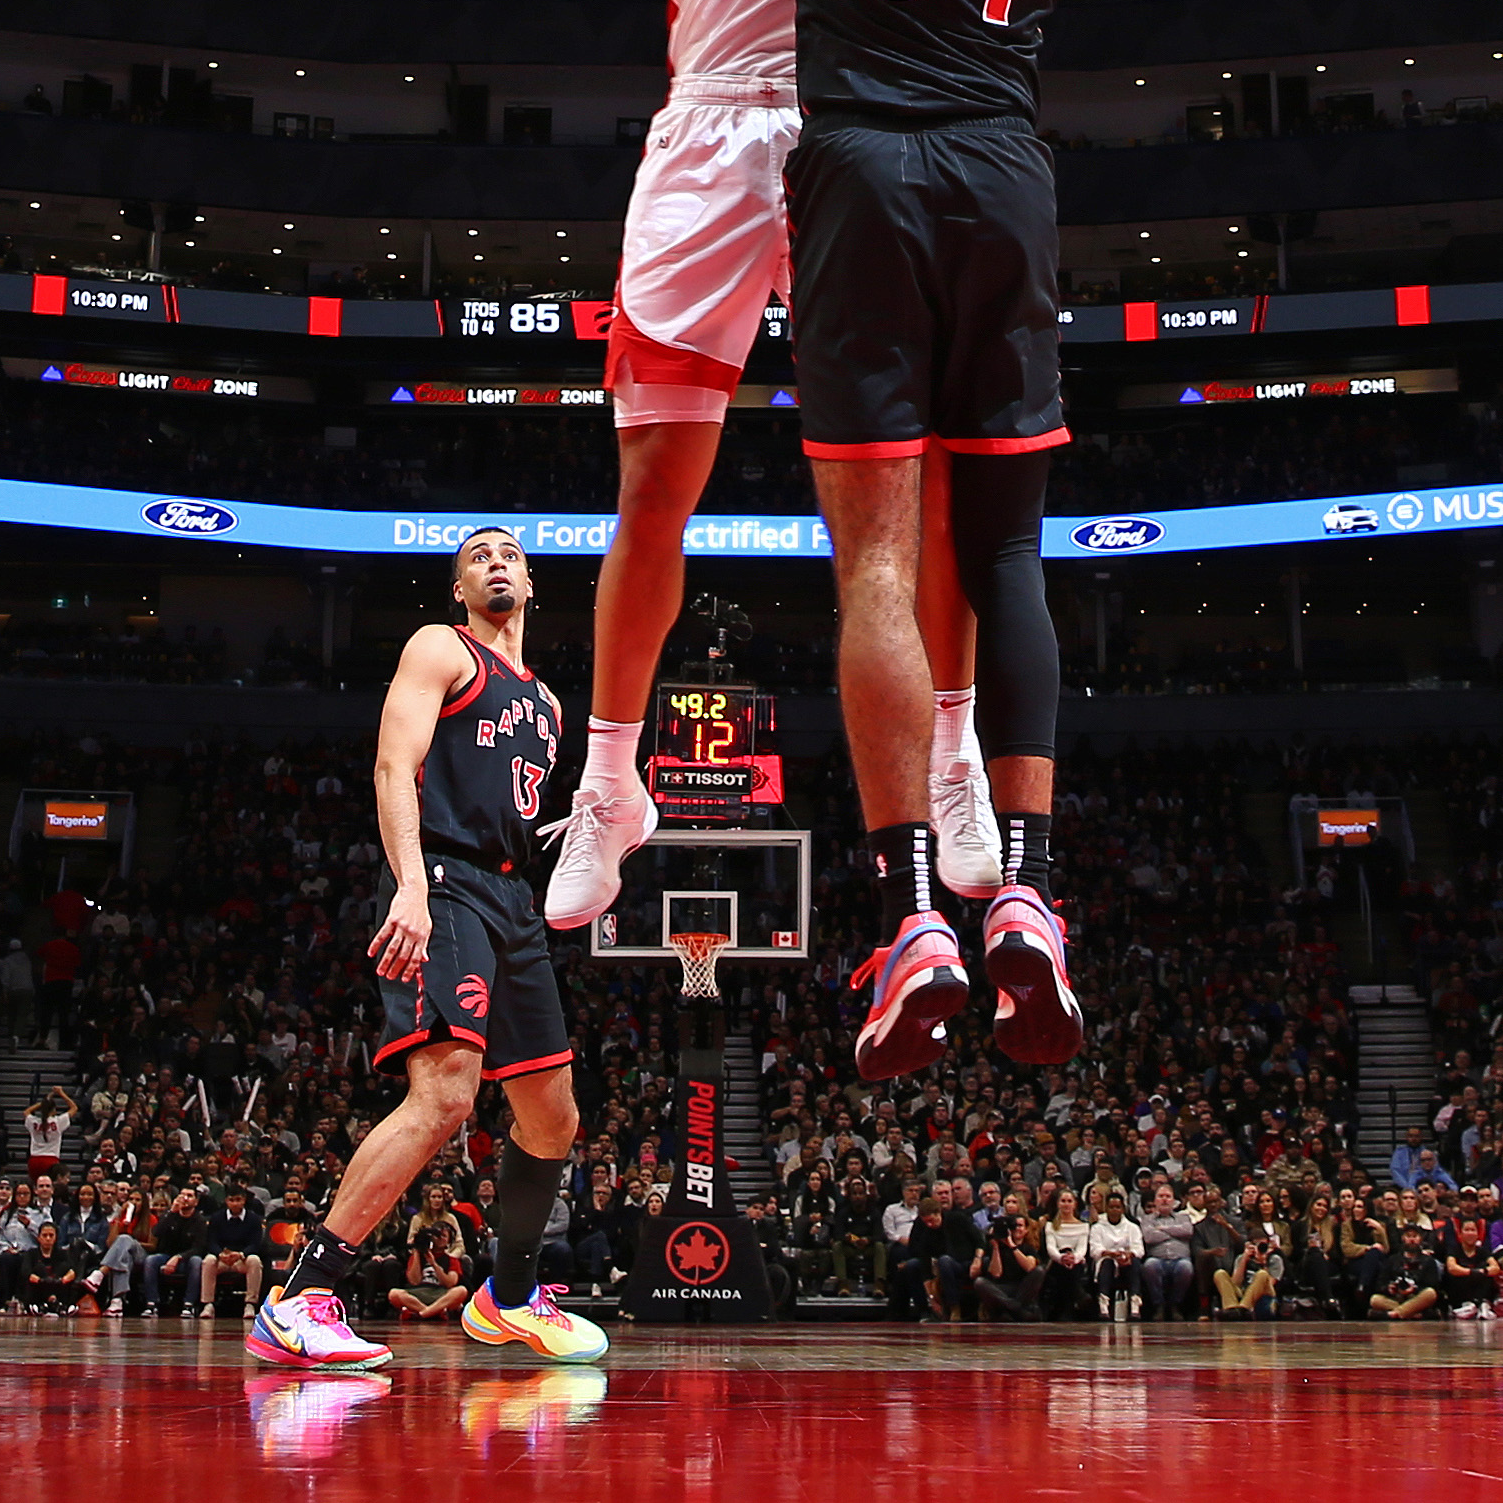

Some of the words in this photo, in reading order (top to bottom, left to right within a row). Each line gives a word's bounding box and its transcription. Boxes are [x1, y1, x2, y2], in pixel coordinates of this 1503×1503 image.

[71, 290, 117, 308] 10:30
[121, 294, 149, 311] PM
[463, 301, 500, 318] TF05
[510, 303, 560, 333] 85
[764, 306, 788, 320] QTR
[1161, 310, 1206, 328] 10:30
[1210, 309, 1237, 326] PM
[460, 318, 479, 336] TO
[481, 318, 495, 335] 4
[768, 322, 782, 337] 3
[118, 372, 170, 390] LIGHT
[213, 378, 259, 397] ZONE
[1256, 383, 1307, 399] LIGHT
[1349, 378, 1396, 396] ZONE
[466, 388, 517, 404] LIGHT
[560, 390, 605, 405] ZONE
[158, 500, 220, 531] Ford
[1089, 521, 1148, 548] Ford
[671, 693, 727, 719] 49.2
[477, 697, 557, 763] RAPTOR
[695, 721, 734, 764] 12
[511, 756, 545, 820] 13
[684, 772, 748, 786] TISSOT
[47, 813, 97, 828] Tangerine
[686, 1080, 716, 1209] POINTSBET
[652, 1288, 677, 1299] AIR
[680, 1287, 742, 1300] CANADA
